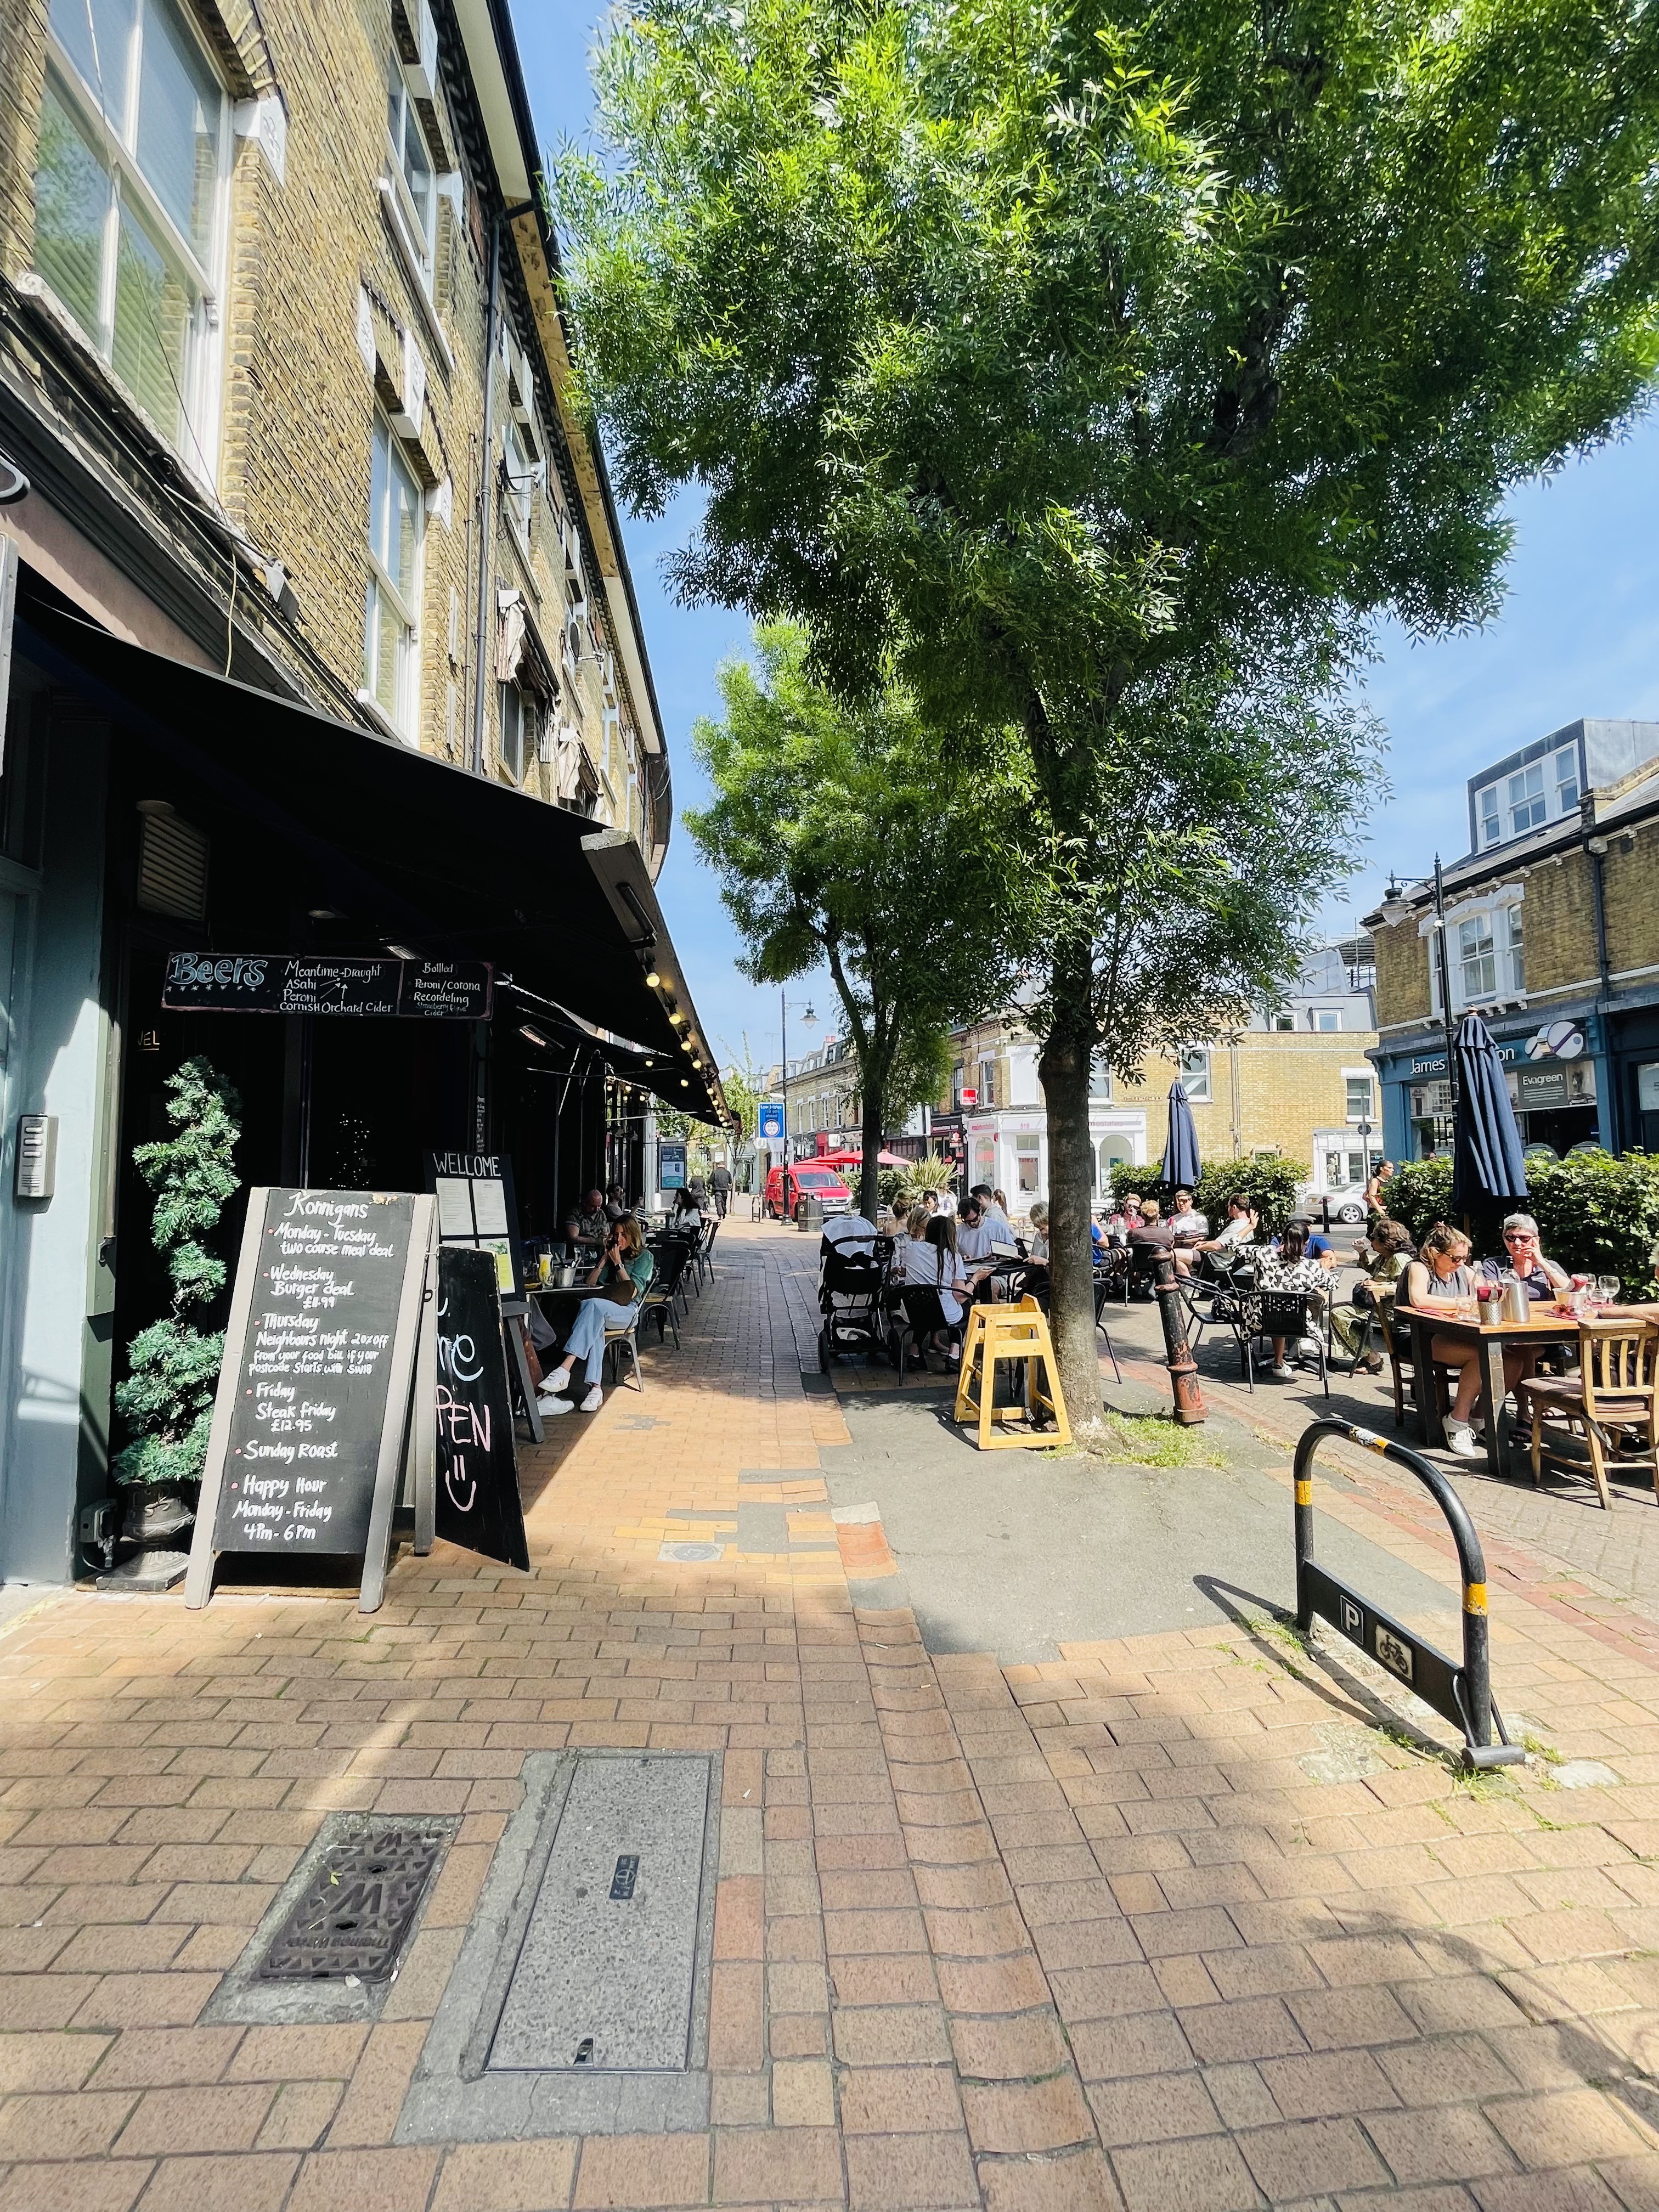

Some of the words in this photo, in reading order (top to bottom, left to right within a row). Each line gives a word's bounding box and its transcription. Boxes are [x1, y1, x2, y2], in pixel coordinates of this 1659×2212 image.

[170, 952, 268, 986] Beers
[284, 960, 339, 978] Meantime
[343, 964, 382, 983] Draught
[283, 989, 316, 1003] Peroni
[321, 1001, 363, 1013] Orchard
[365, 1001, 393, 1013] Cider
[1410, 1058, 1446, 1075] James
[432, 1153, 501, 1177] WELCOME
[274, 1221, 322, 1244] Monday
[333, 1224, 376, 1247] Tuesday
[279, 1240, 303, 1255] two
[304, 1243, 339, 1255] course
[340, 1243, 366, 1257] meal
[368, 1242, 394, 1257] deal
[269, 1263, 334, 1284] Wednesday
[269, 1280, 319, 1300] Burger
[323, 1281, 356, 1296] deal
[261, 1313, 319, 1333] Thursday
[255, 1330, 317, 1354] Neighbours
[319, 1328, 349, 1351] night
[253, 1350, 275, 1364] from
[278, 1351, 301, 1365] your
[302, 1349, 325, 1363] food
[327, 1350, 344, 1361] bill
[249, 1362, 290, 1378] postcode
[324, 1362, 343, 1374] with
[347, 1364, 373, 1374] SW18
[256, 1381, 296, 1402] Friday
[255, 1401, 297, 1420] Steak
[436, 1384, 491, 1452] PEN
[270, 1419, 313, 1433] £12.95
[243, 1440, 295, 1465] Sunday
[297, 1440, 339, 1459] Roast
[242, 1474, 290, 1498] Happy
[295, 1476, 328, 1493] Hour
[232, 1499, 284, 1522] Monday
[292, 1500, 333, 1522] Friday
[1345, 1602, 1359, 1631] P
